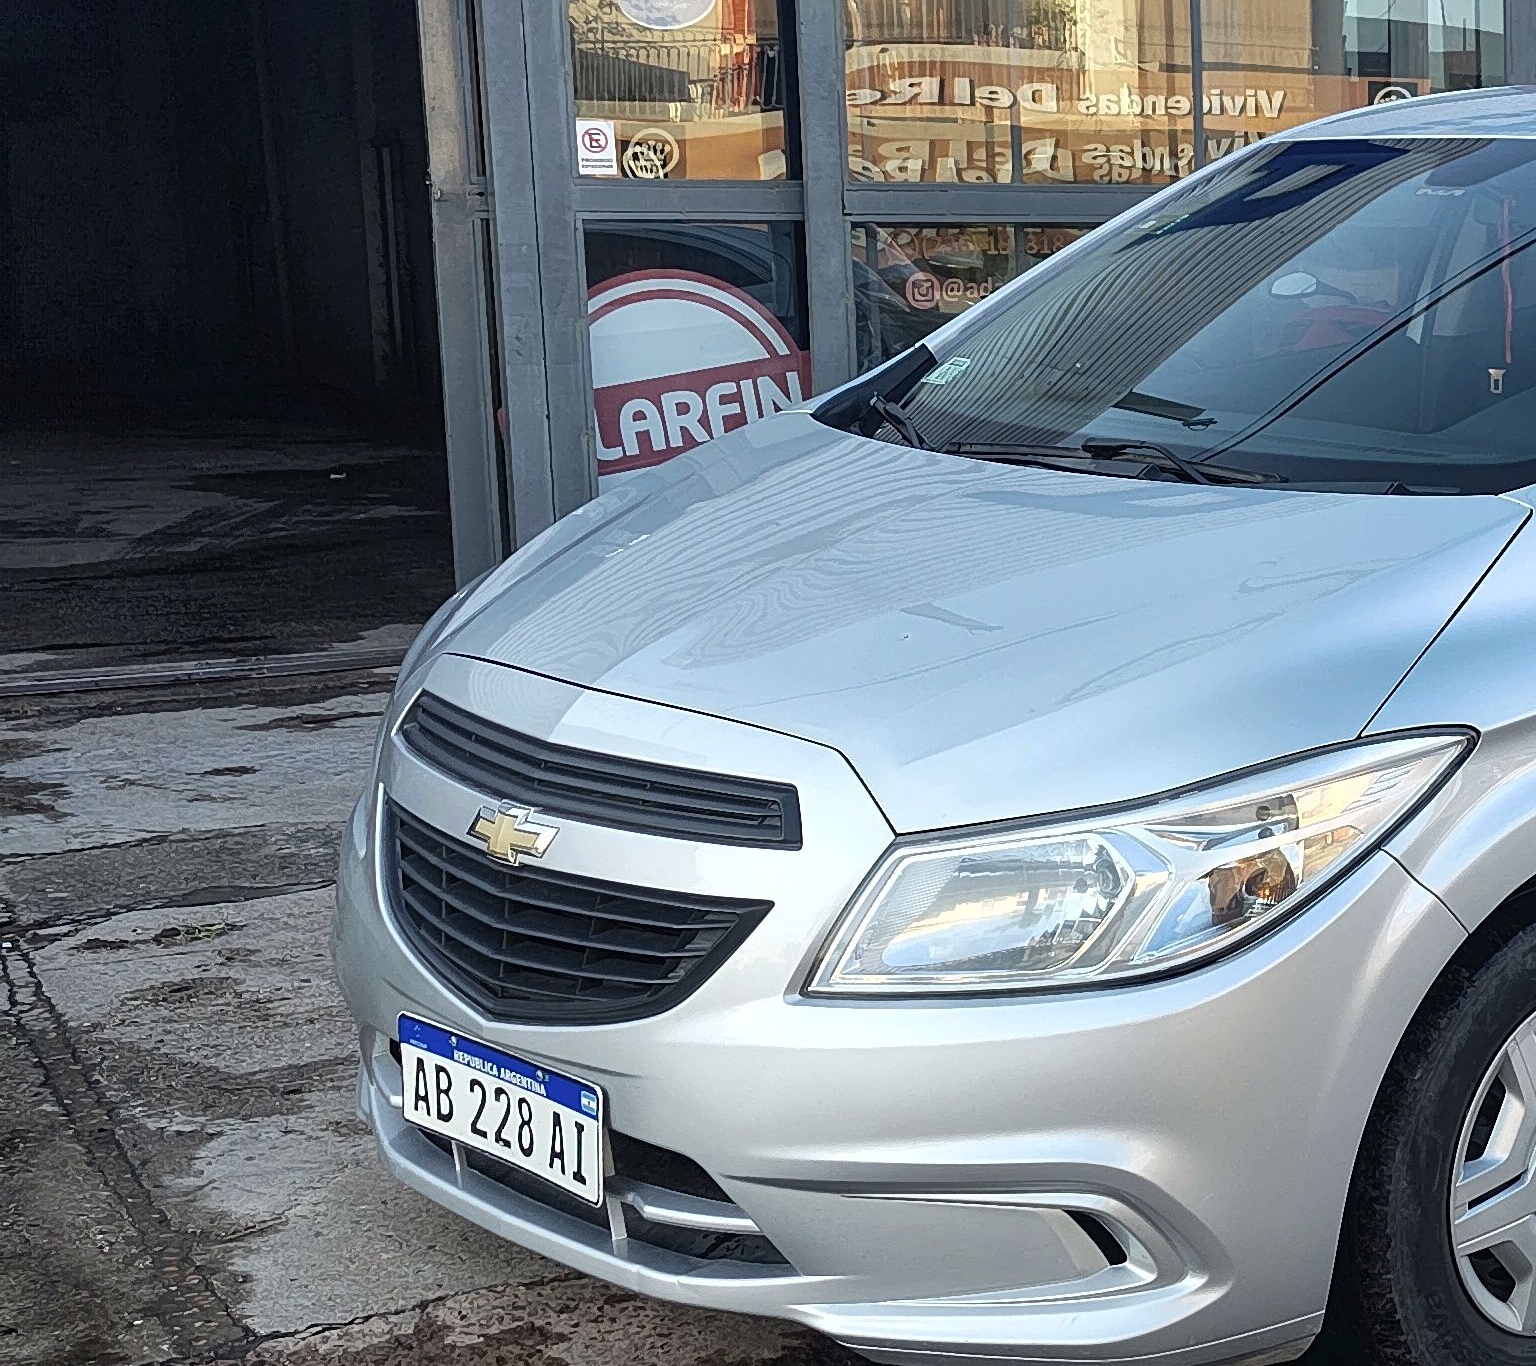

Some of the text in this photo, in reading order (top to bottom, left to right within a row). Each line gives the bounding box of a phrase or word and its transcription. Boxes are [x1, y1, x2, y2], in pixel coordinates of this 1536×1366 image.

[414, 1056, 587, 1186] AB 228 AI
